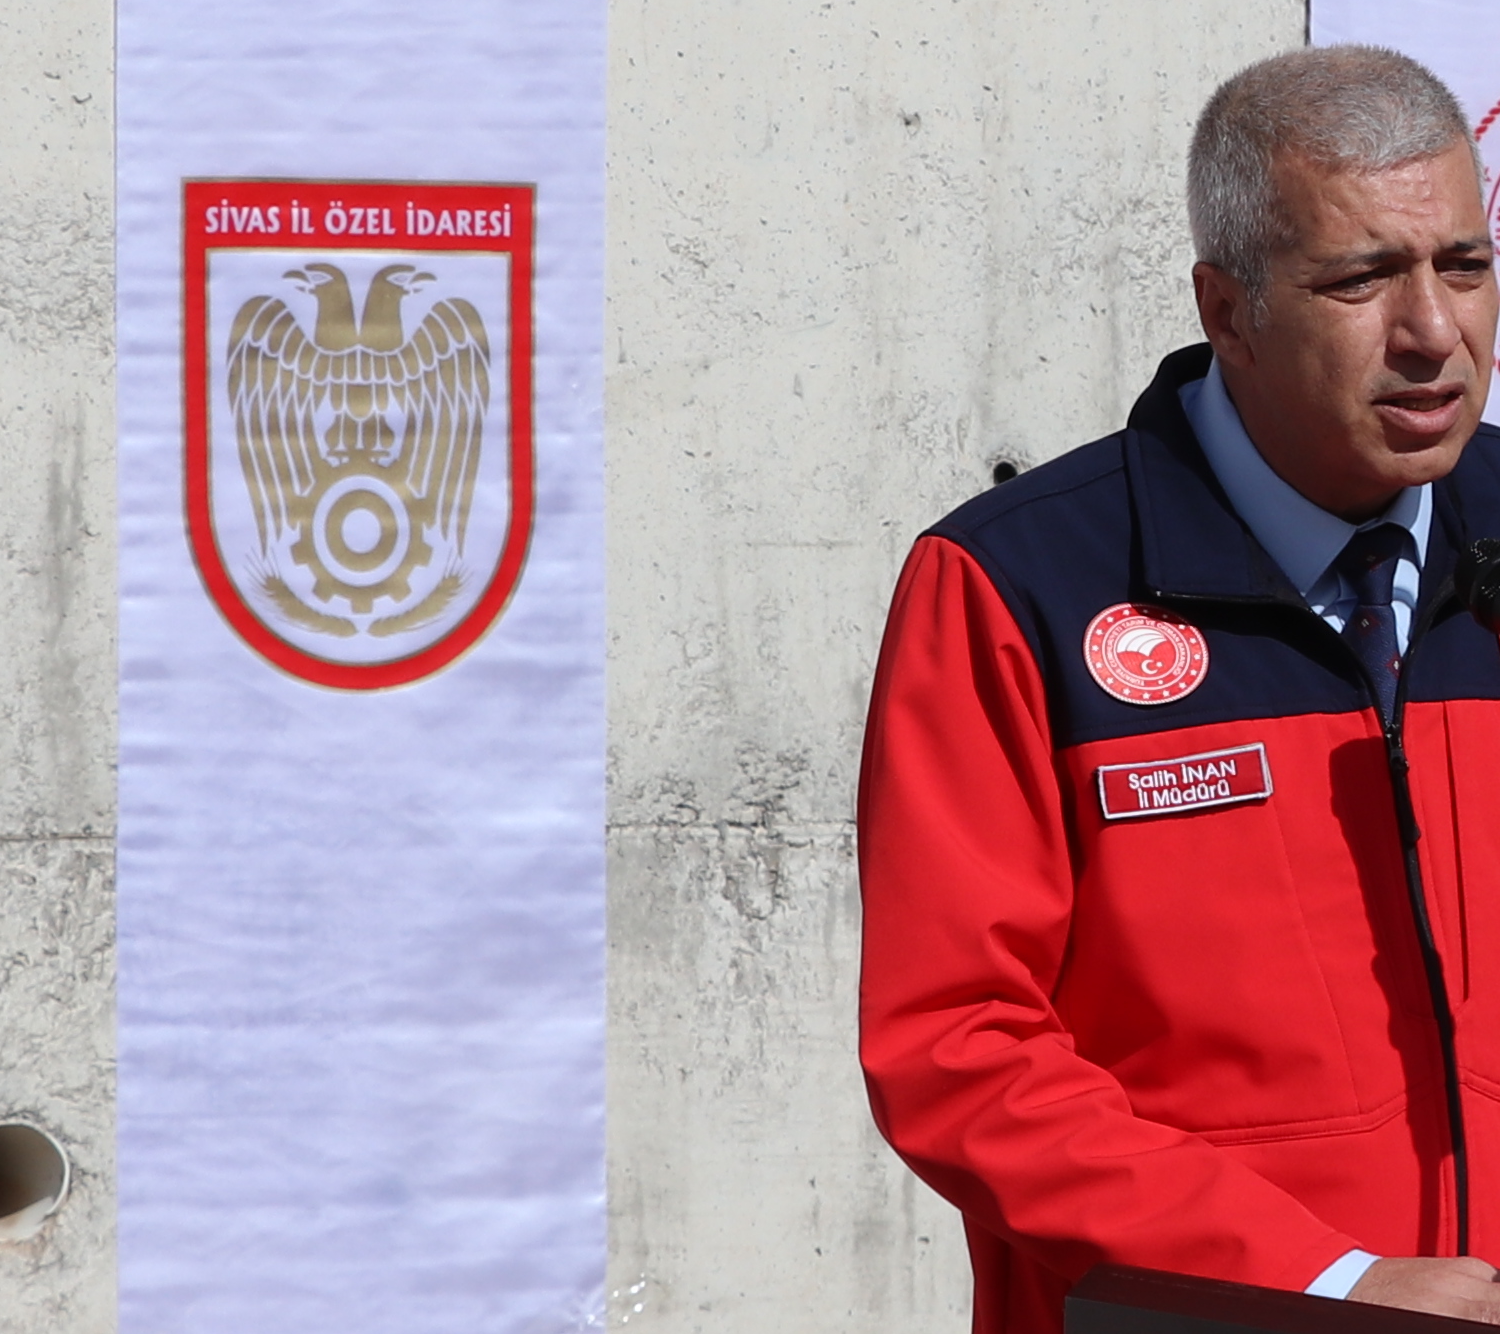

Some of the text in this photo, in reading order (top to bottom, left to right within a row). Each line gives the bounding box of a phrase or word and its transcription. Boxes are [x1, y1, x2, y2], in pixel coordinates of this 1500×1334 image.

[205, 199, 511, 237] SİVAS İL ÖZEL İDARESİ
[1128, 759, 1236, 789] Salih İNAN
[1153, 779, 1231, 807] Müdürü
